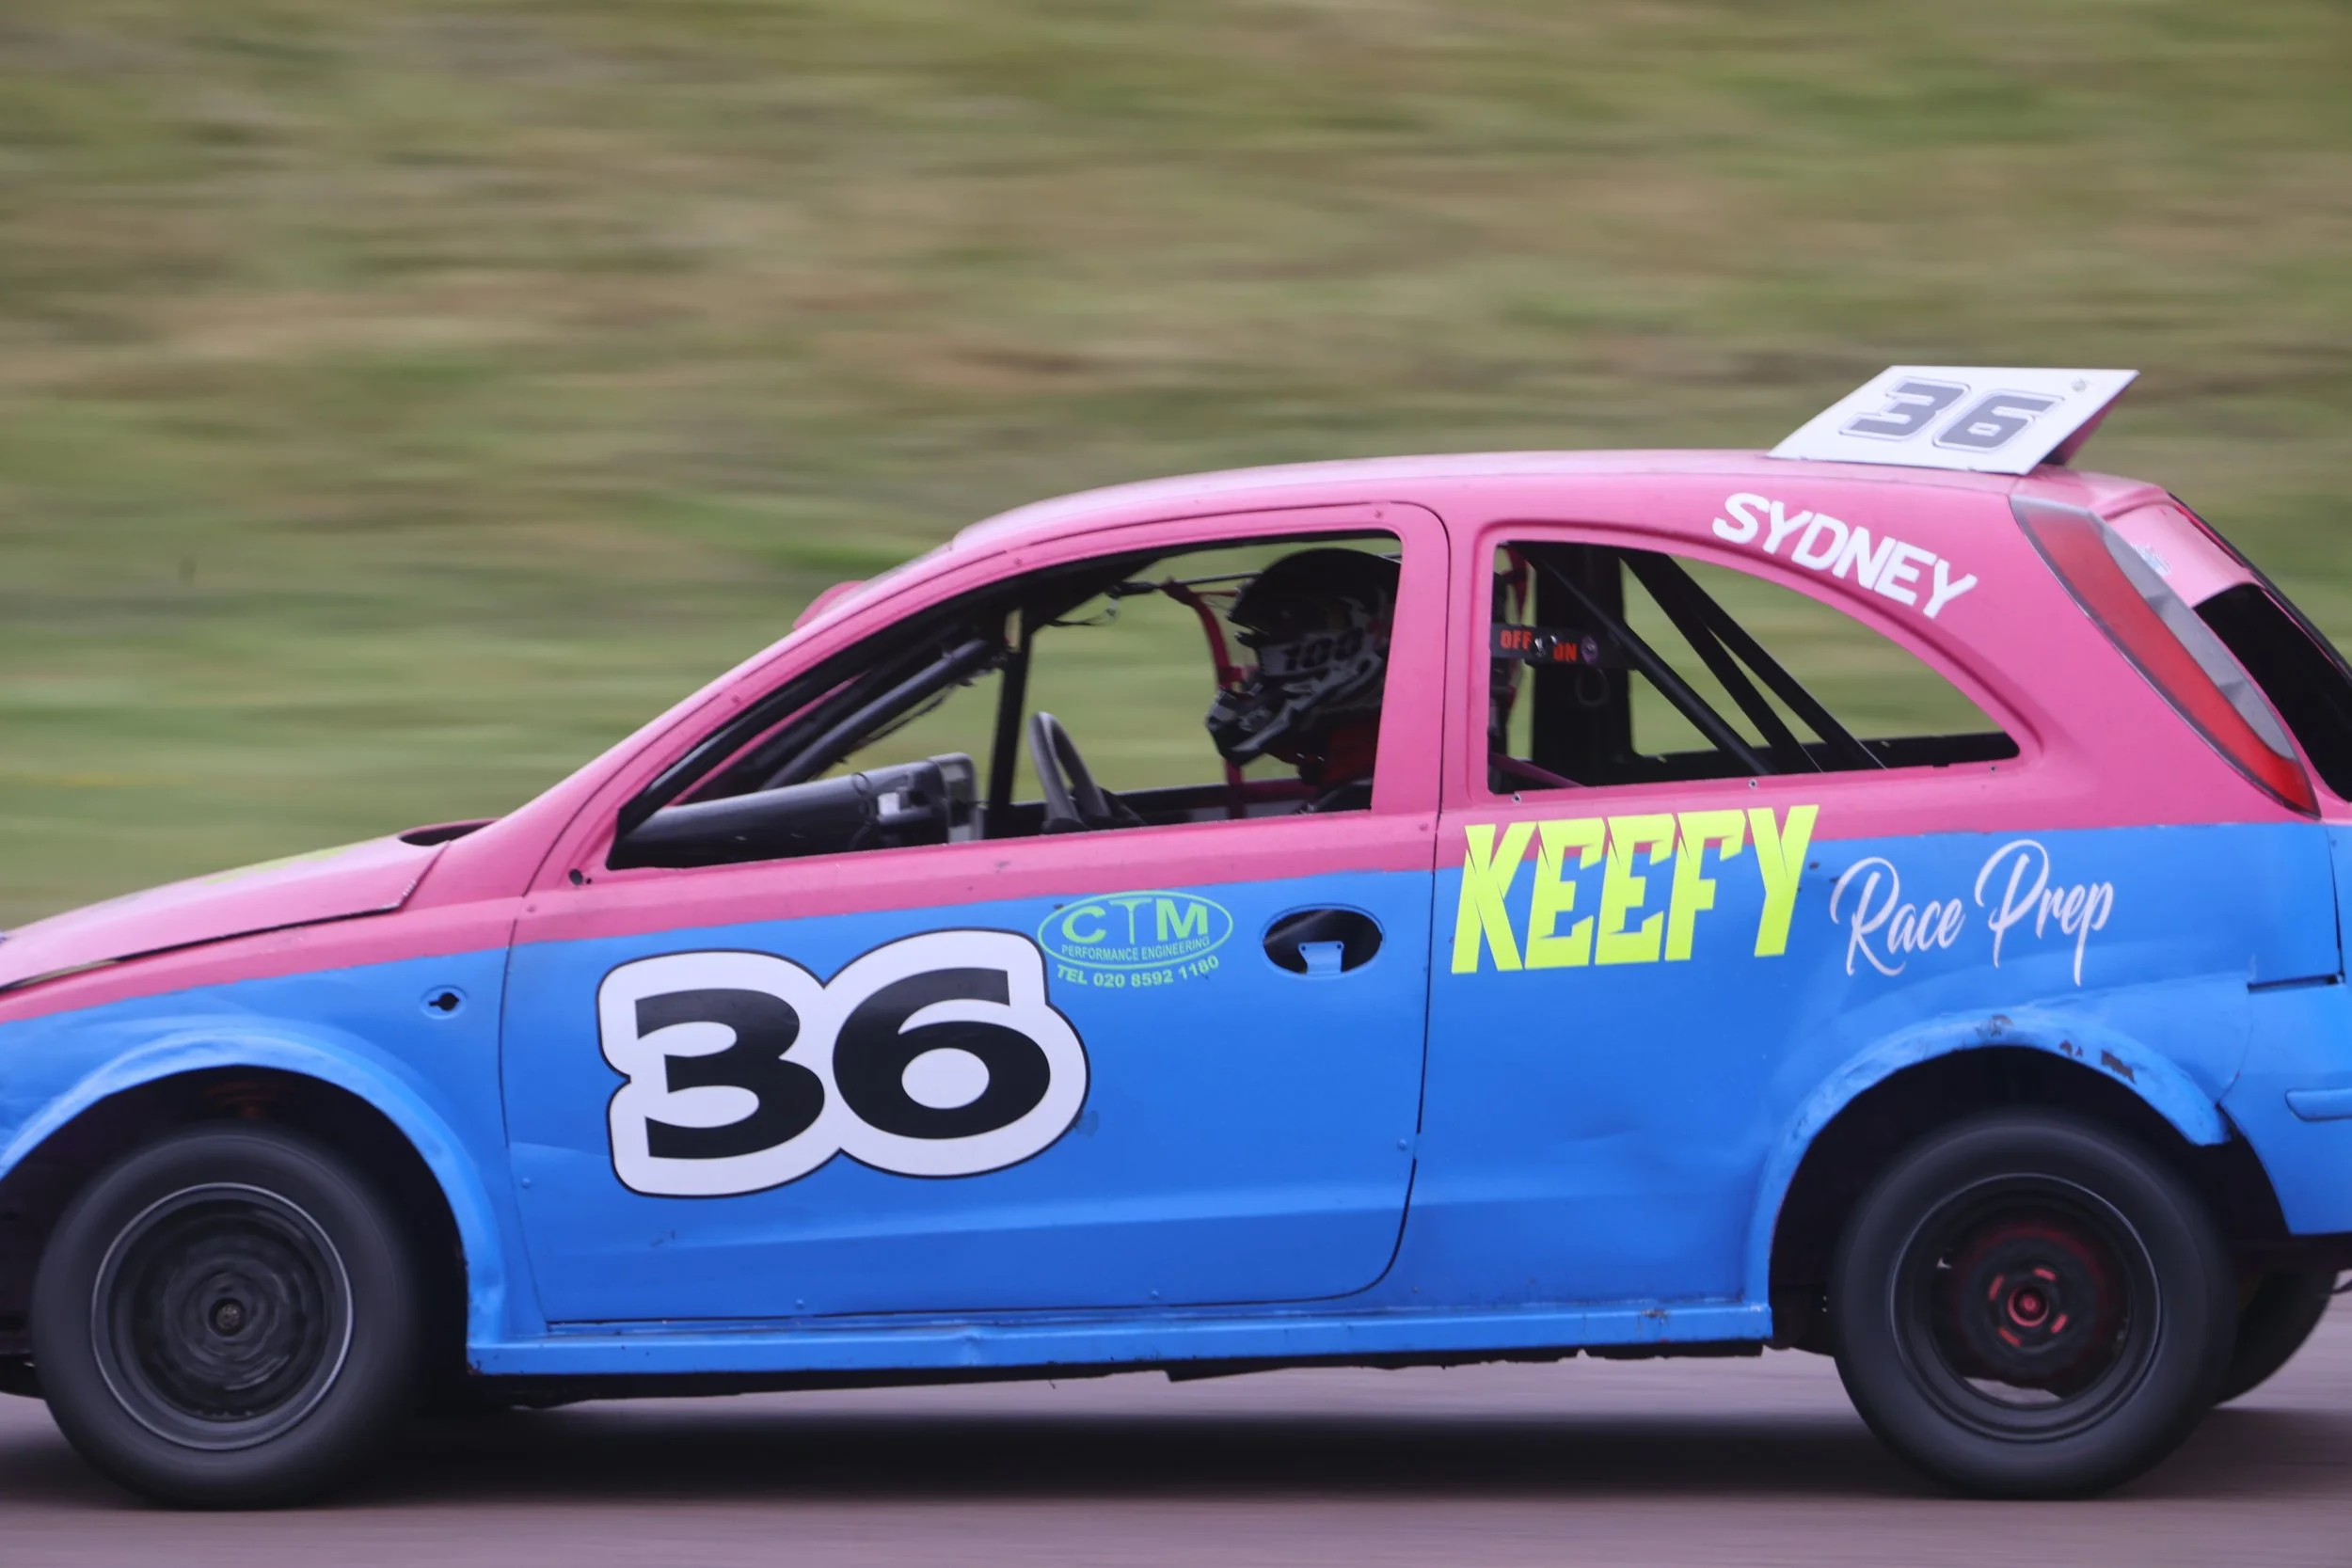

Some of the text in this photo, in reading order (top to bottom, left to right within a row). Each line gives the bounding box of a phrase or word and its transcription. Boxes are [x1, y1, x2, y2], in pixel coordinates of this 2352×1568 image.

[1838, 375, 2065, 453] 36
[1712, 492, 1978, 619] SYDNEY
[1500, 630, 1533, 651] OFF
[1553, 643, 1578, 662] ON
[1451, 804, 1820, 974] KEEFY
[1830, 839, 2114, 987] Race Prep
[1061, 897, 1209, 945] CTM
[1061, 936, 1212, 962] PERFORMANCE ENGINEERING
[1057, 955, 1220, 989] TEL 020 8592 1180
[633, 966, 1052, 1161] 36
